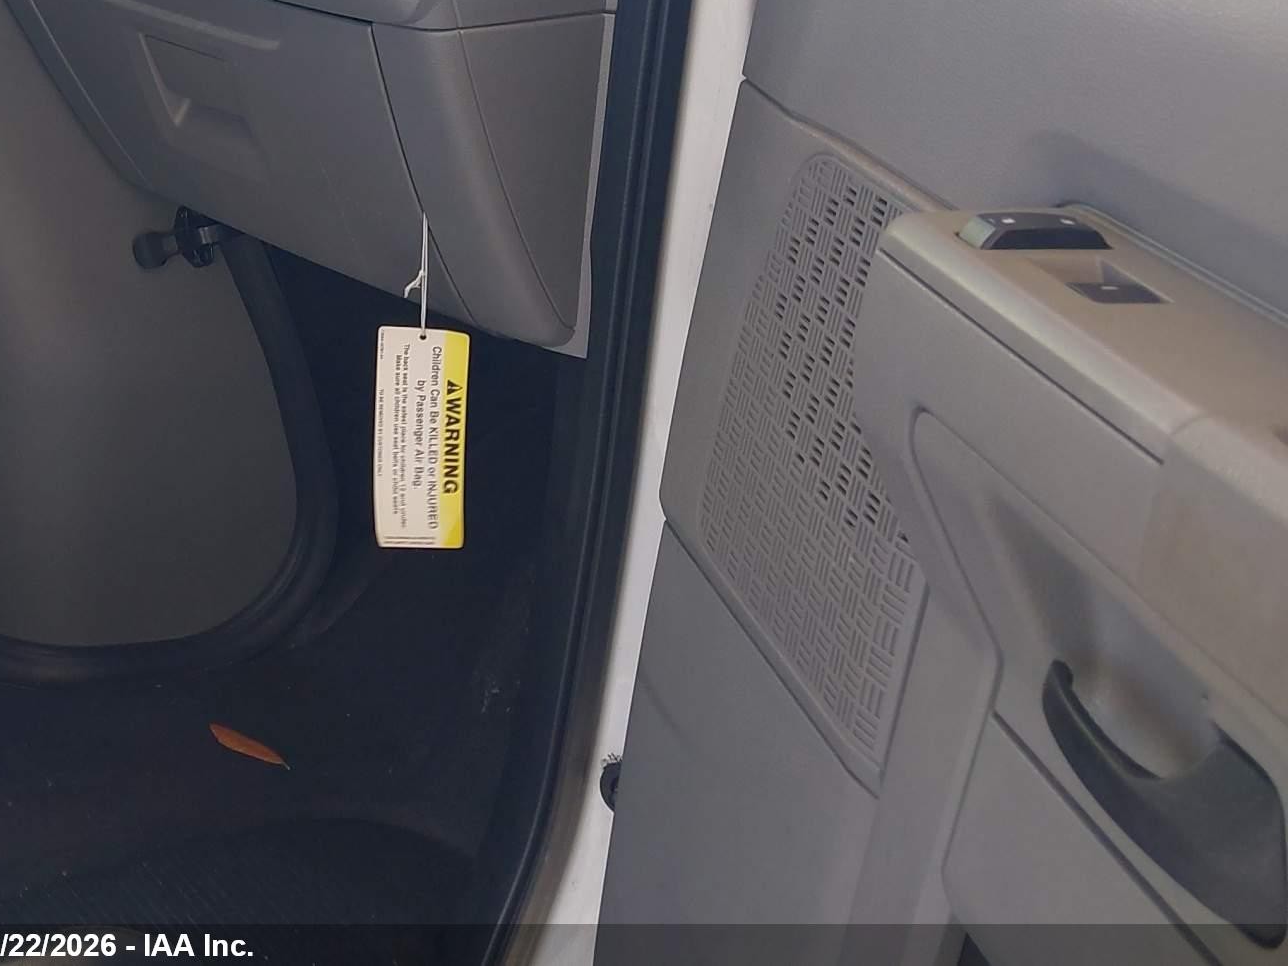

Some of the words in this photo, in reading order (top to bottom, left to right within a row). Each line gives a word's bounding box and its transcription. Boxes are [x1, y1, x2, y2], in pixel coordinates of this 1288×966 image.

[432, 346, 442, 386] Children
[415, 380, 426, 391] by
[431, 389, 440, 408] Can
[413, 395, 425, 445] Passenger
[430, 411, 439, 423] Be
[415, 450, 423, 463] Air
[428, 427, 437, 464] KILLED
[443, 397, 461, 494] WARNING
[413, 467, 423, 489] Bag.
[428, 467, 435, 477] or
[427, 481, 438, 529] INJURED
